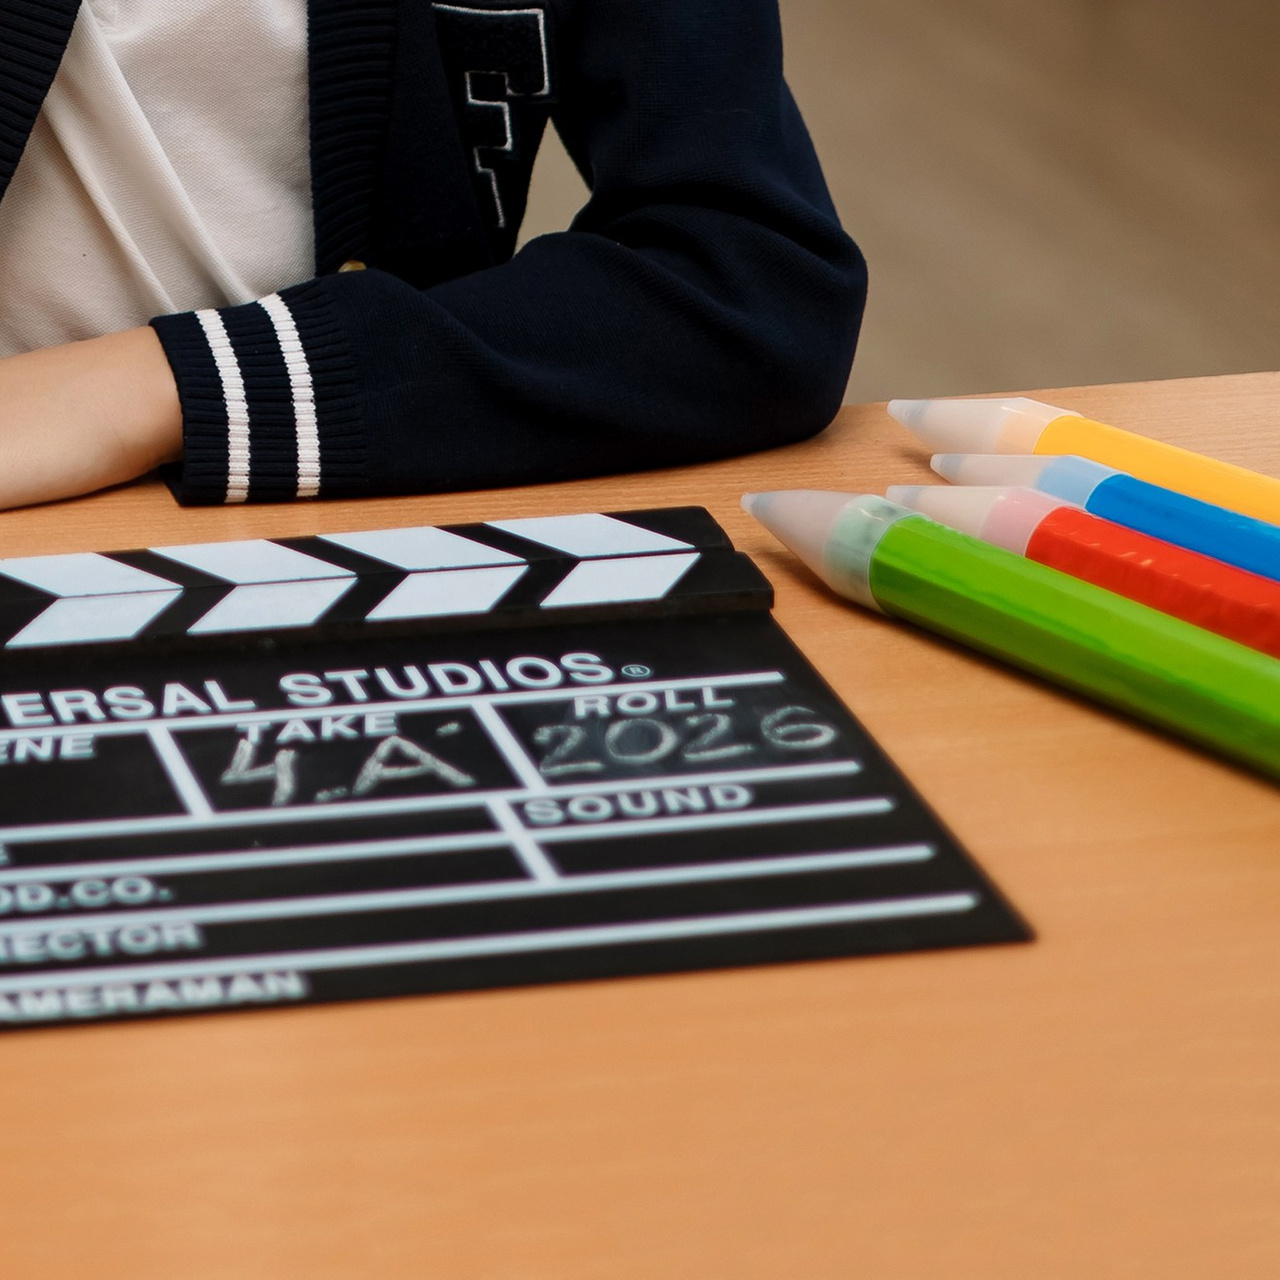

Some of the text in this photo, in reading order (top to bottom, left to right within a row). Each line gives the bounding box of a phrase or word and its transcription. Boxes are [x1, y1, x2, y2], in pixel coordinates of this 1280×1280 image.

[572, 685, 736, 719] ROLL
[235, 711, 398, 744] TAKE
[532, 705, 839, 778] 2026
[523, 784, 754, 824] SOUND
